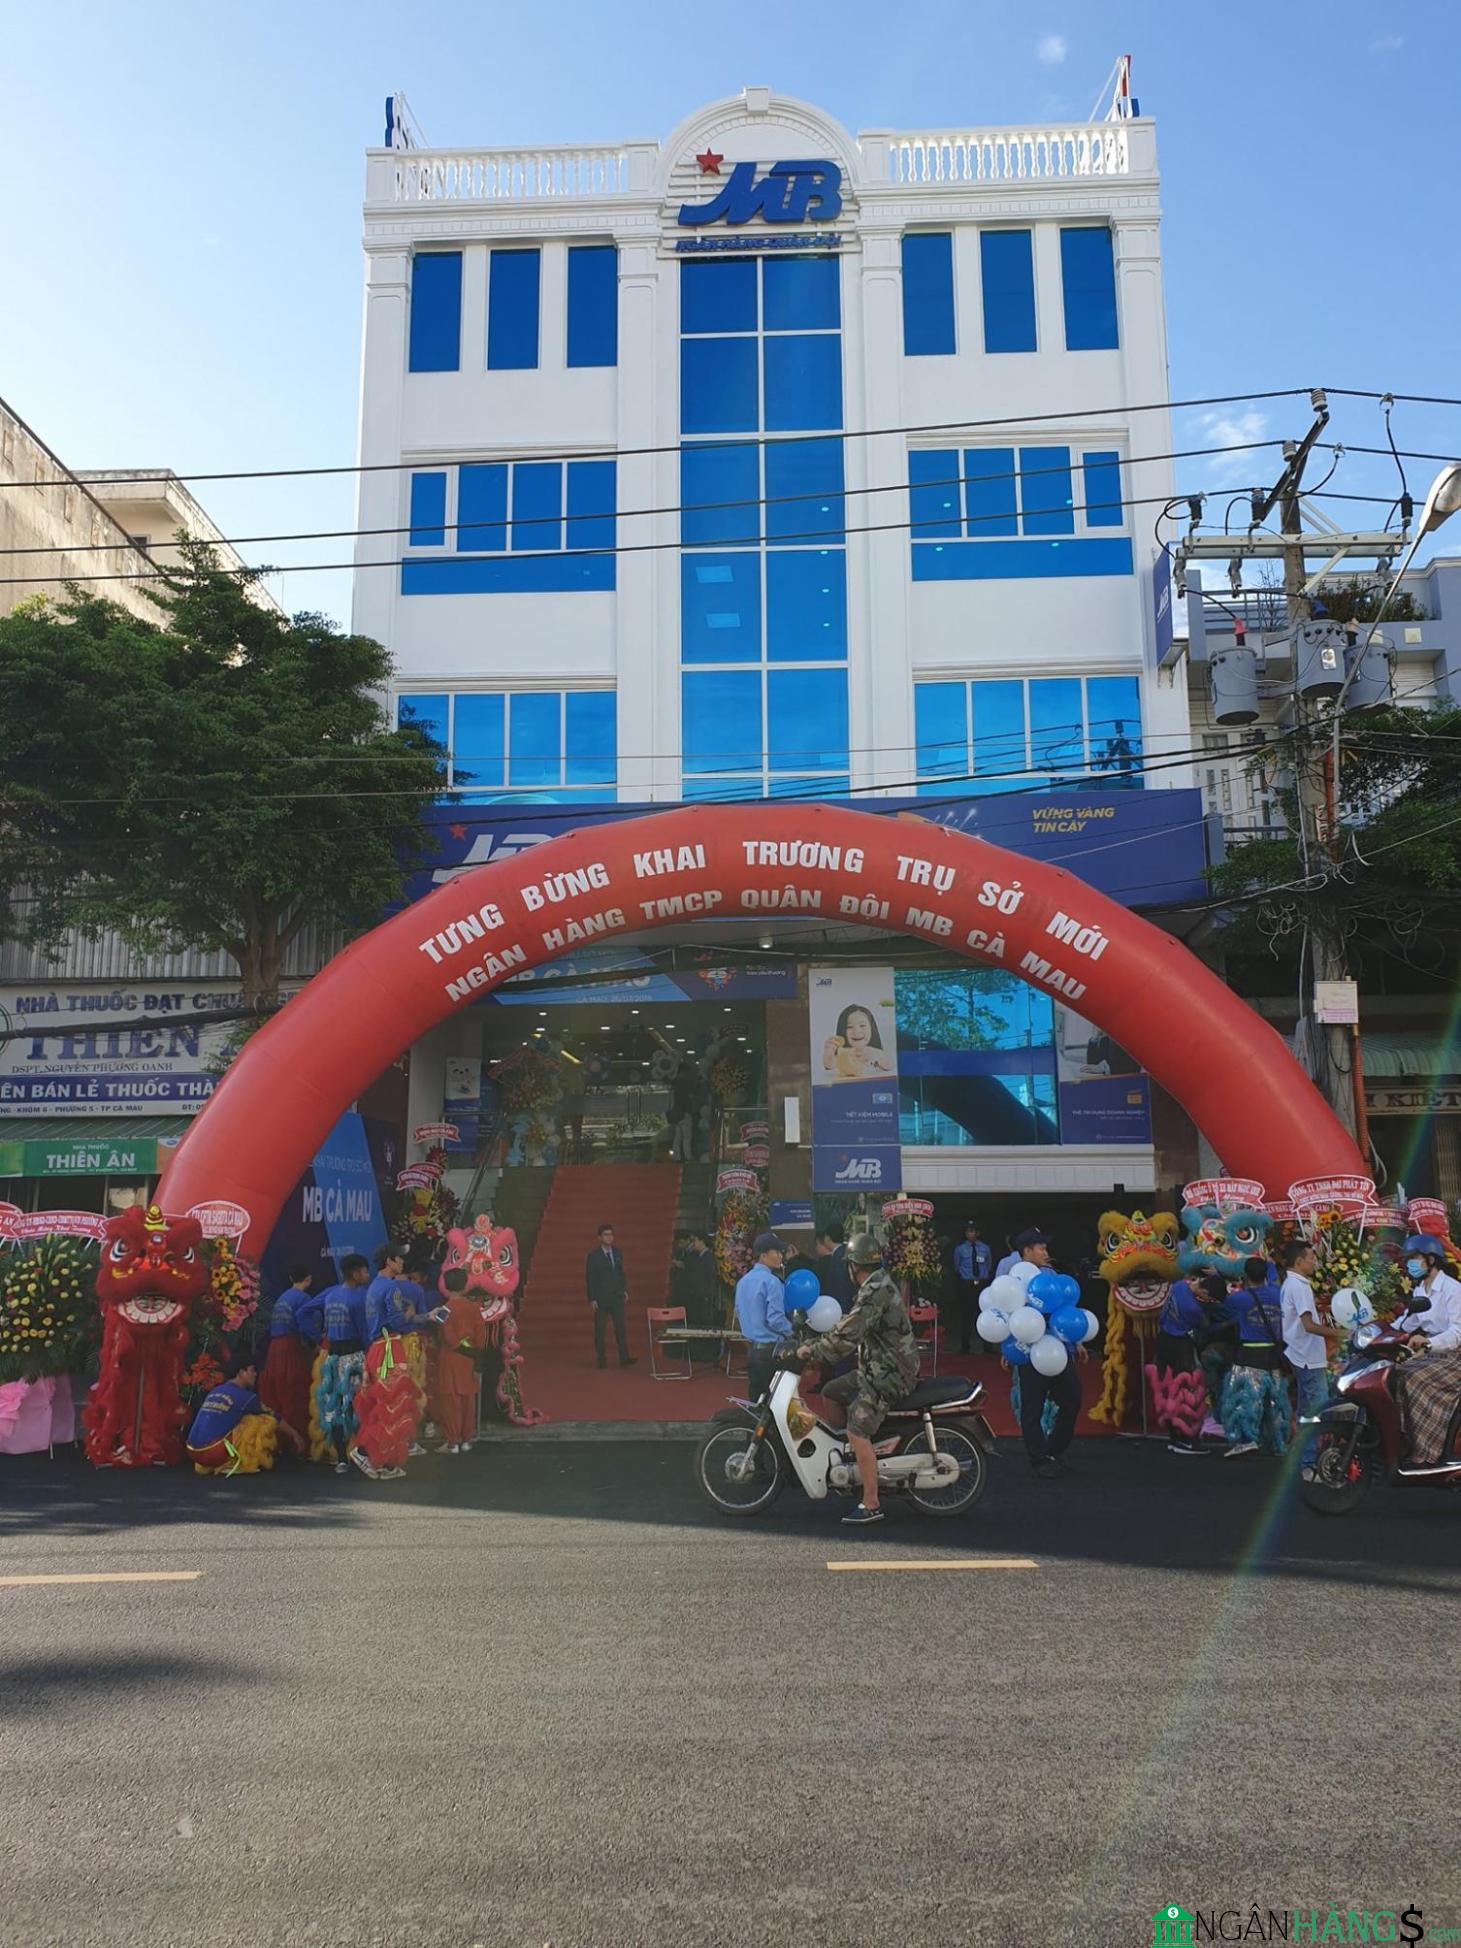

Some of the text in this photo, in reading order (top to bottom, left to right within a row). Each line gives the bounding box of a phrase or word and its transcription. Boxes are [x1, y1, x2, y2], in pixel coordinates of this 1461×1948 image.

[678, 160, 842, 226] MB
[1032, 806, 1115, 820] VỮNG VÀNG
[1033, 823, 1056, 833] TIN
[520, 863, 610, 912] BỪNG
[633, 844, 706, 878] KHAI
[743, 840, 864, 873] TRƯƠNG
[896, 855, 956, 896] TRỤ
[978, 880, 1024, 915] SỞ
[1045, 911, 1110, 961] MỚI
[445, 944, 527, 1001] NGÂN
[542, 907, 626, 950] HÀNG
[640, 890, 722, 921] TMCP
[741, 884, 821, 909] QUÂN
[840, 892, 890, 920] ĐỘI
[905, 907, 954, 936] MB
[967, 930, 1006, 958] CÀ
[1019, 951, 1087, 1000] MAU
[16, 992, 60, 1013] NHÀ
[66, 988, 138, 1012] THUỐC
[144, 994, 185, 1014] ĐẠT
[31, 1080, 71, 1098] BÁN
[76, 1078, 99, 1098] LẺ
[106, 1076, 171, 1097] THUỐC
[177, 1079, 219, 1097] THÀ
[46, 1150, 135, 1169] THIÊN ÂN
[835, 1158, 882, 1179] MB
[303, 1186, 323, 1222] MB
[346, 1189, 373, 1222] MAU
